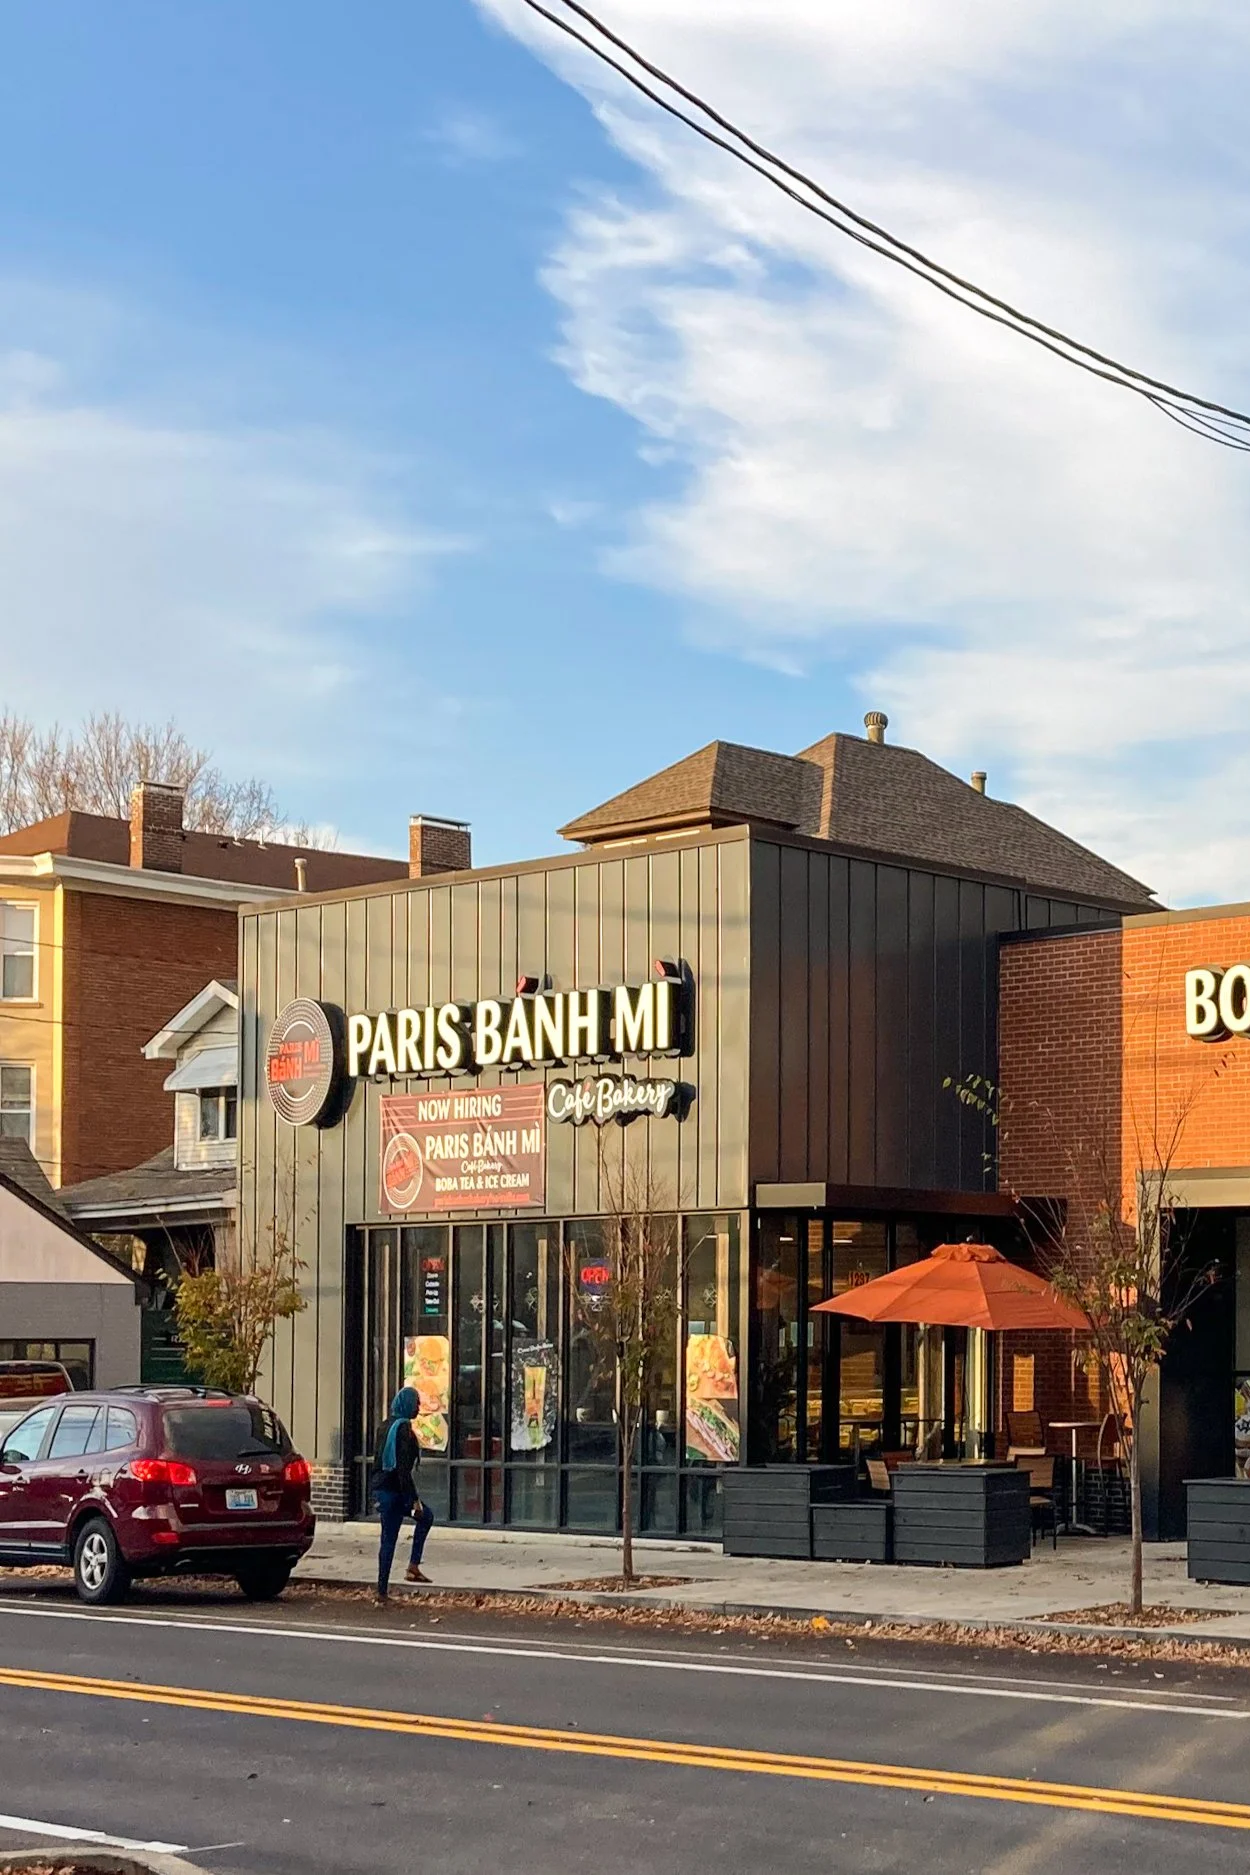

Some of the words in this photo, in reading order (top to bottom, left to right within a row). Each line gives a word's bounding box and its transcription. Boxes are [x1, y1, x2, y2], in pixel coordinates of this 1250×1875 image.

[348, 1002, 462, 1077] PARIS
[475, 976, 600, 1065] BÁNH
[418, 1099, 451, 1122] NOW
[454, 1094, 502, 1119] HIRING
[547, 1081, 595, 1120] Café
[596, 1078, 671, 1117] Bakery
[425, 1133, 469, 1160] PARIS
[473, 1124, 517, 1156] BÁNH
[521, 1122, 541, 1154] MÌ
[435, 1178, 458, 1192] BOBA
[460, 1176, 475, 1190] TEA
[476, 1177, 484, 1189] &
[485, 1175, 498, 1189] ICE
[500, 1173, 530, 1188] CREAM
